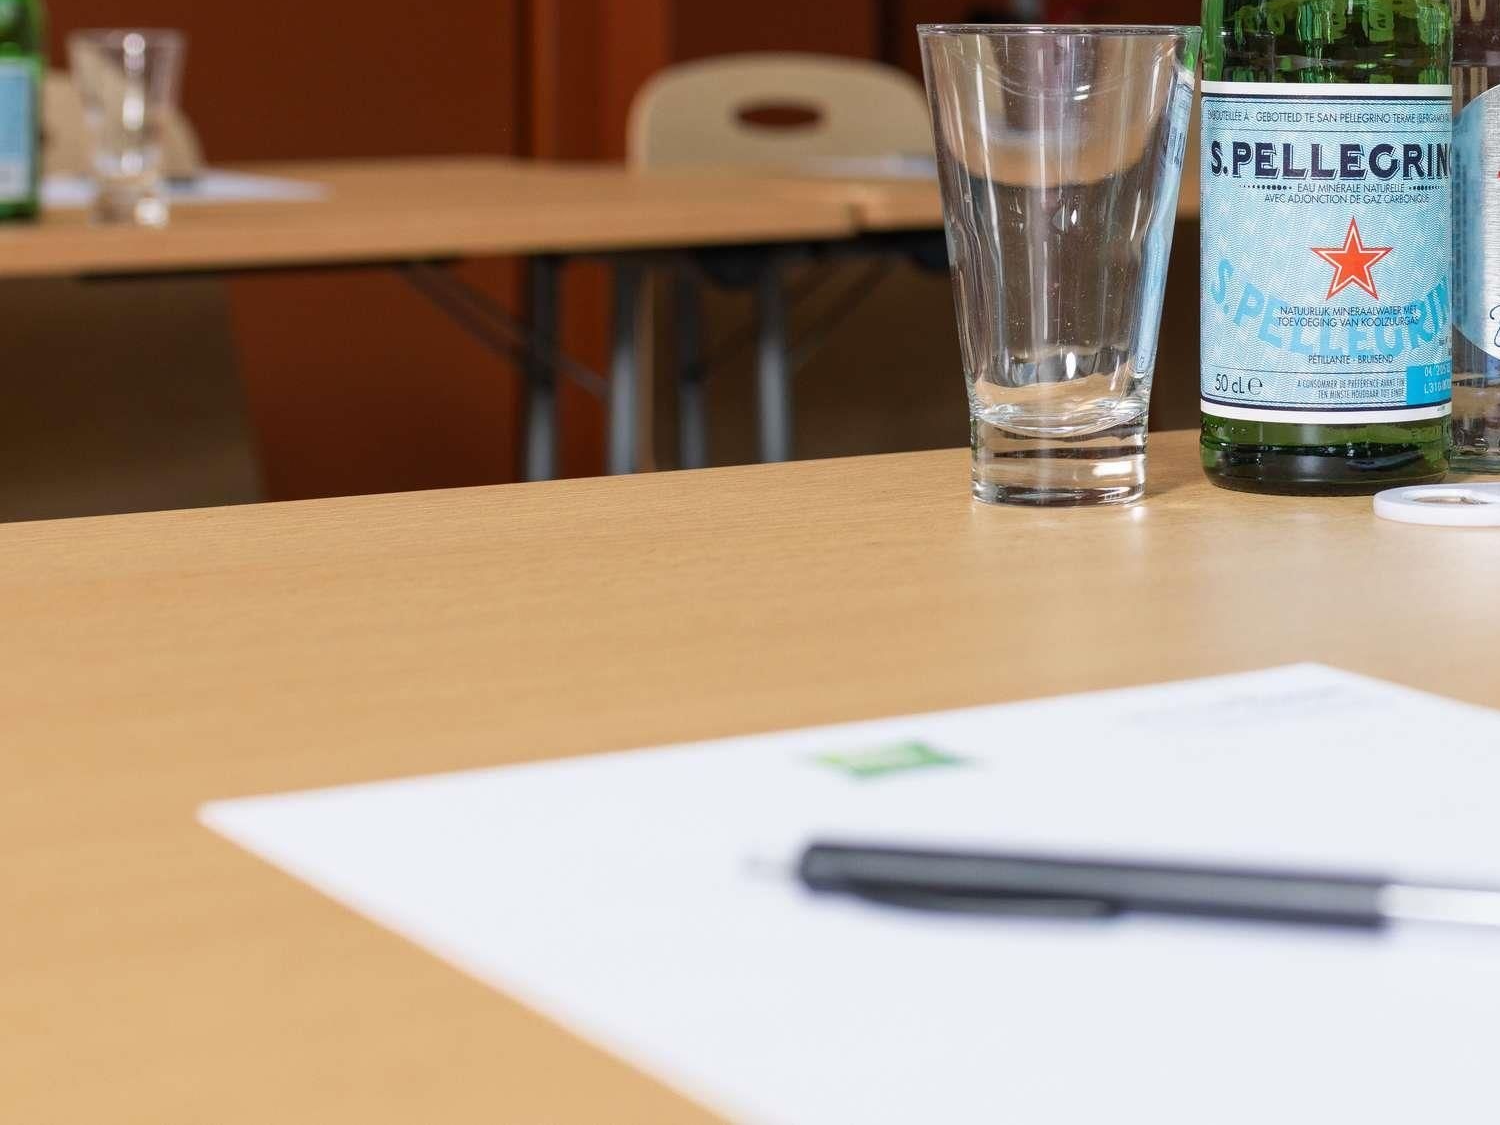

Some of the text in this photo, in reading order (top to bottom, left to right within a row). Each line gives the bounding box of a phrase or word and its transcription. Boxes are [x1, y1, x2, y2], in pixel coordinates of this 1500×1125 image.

[1256, 111, 1302, 123] GEBOTTELD
[1304, 112, 1315, 123] TE
[1317, 112, 1337, 123] SAN
[1340, 113, 1391, 124] PELLEGRINO
[1393, 113, 1415, 124] TERME
[1211, 140, 1450, 181] S.PELLEGRIN
[1297, 182, 1405, 194] EAU MINÉRALE NATURELLE
[1264, 194, 1429, 204] AVEC ADJONCTION DE GAZ CARBONIQUE
[1280, 305, 1417, 316] NATUURLIJK MINERAALWATER MET
[1278, 316, 1419, 327] TOEVOEGING VAN KOOLZUURGAS
[1357, 354, 1393, 364] BRUISEND
[1214, 373, 1228, 392] 50
